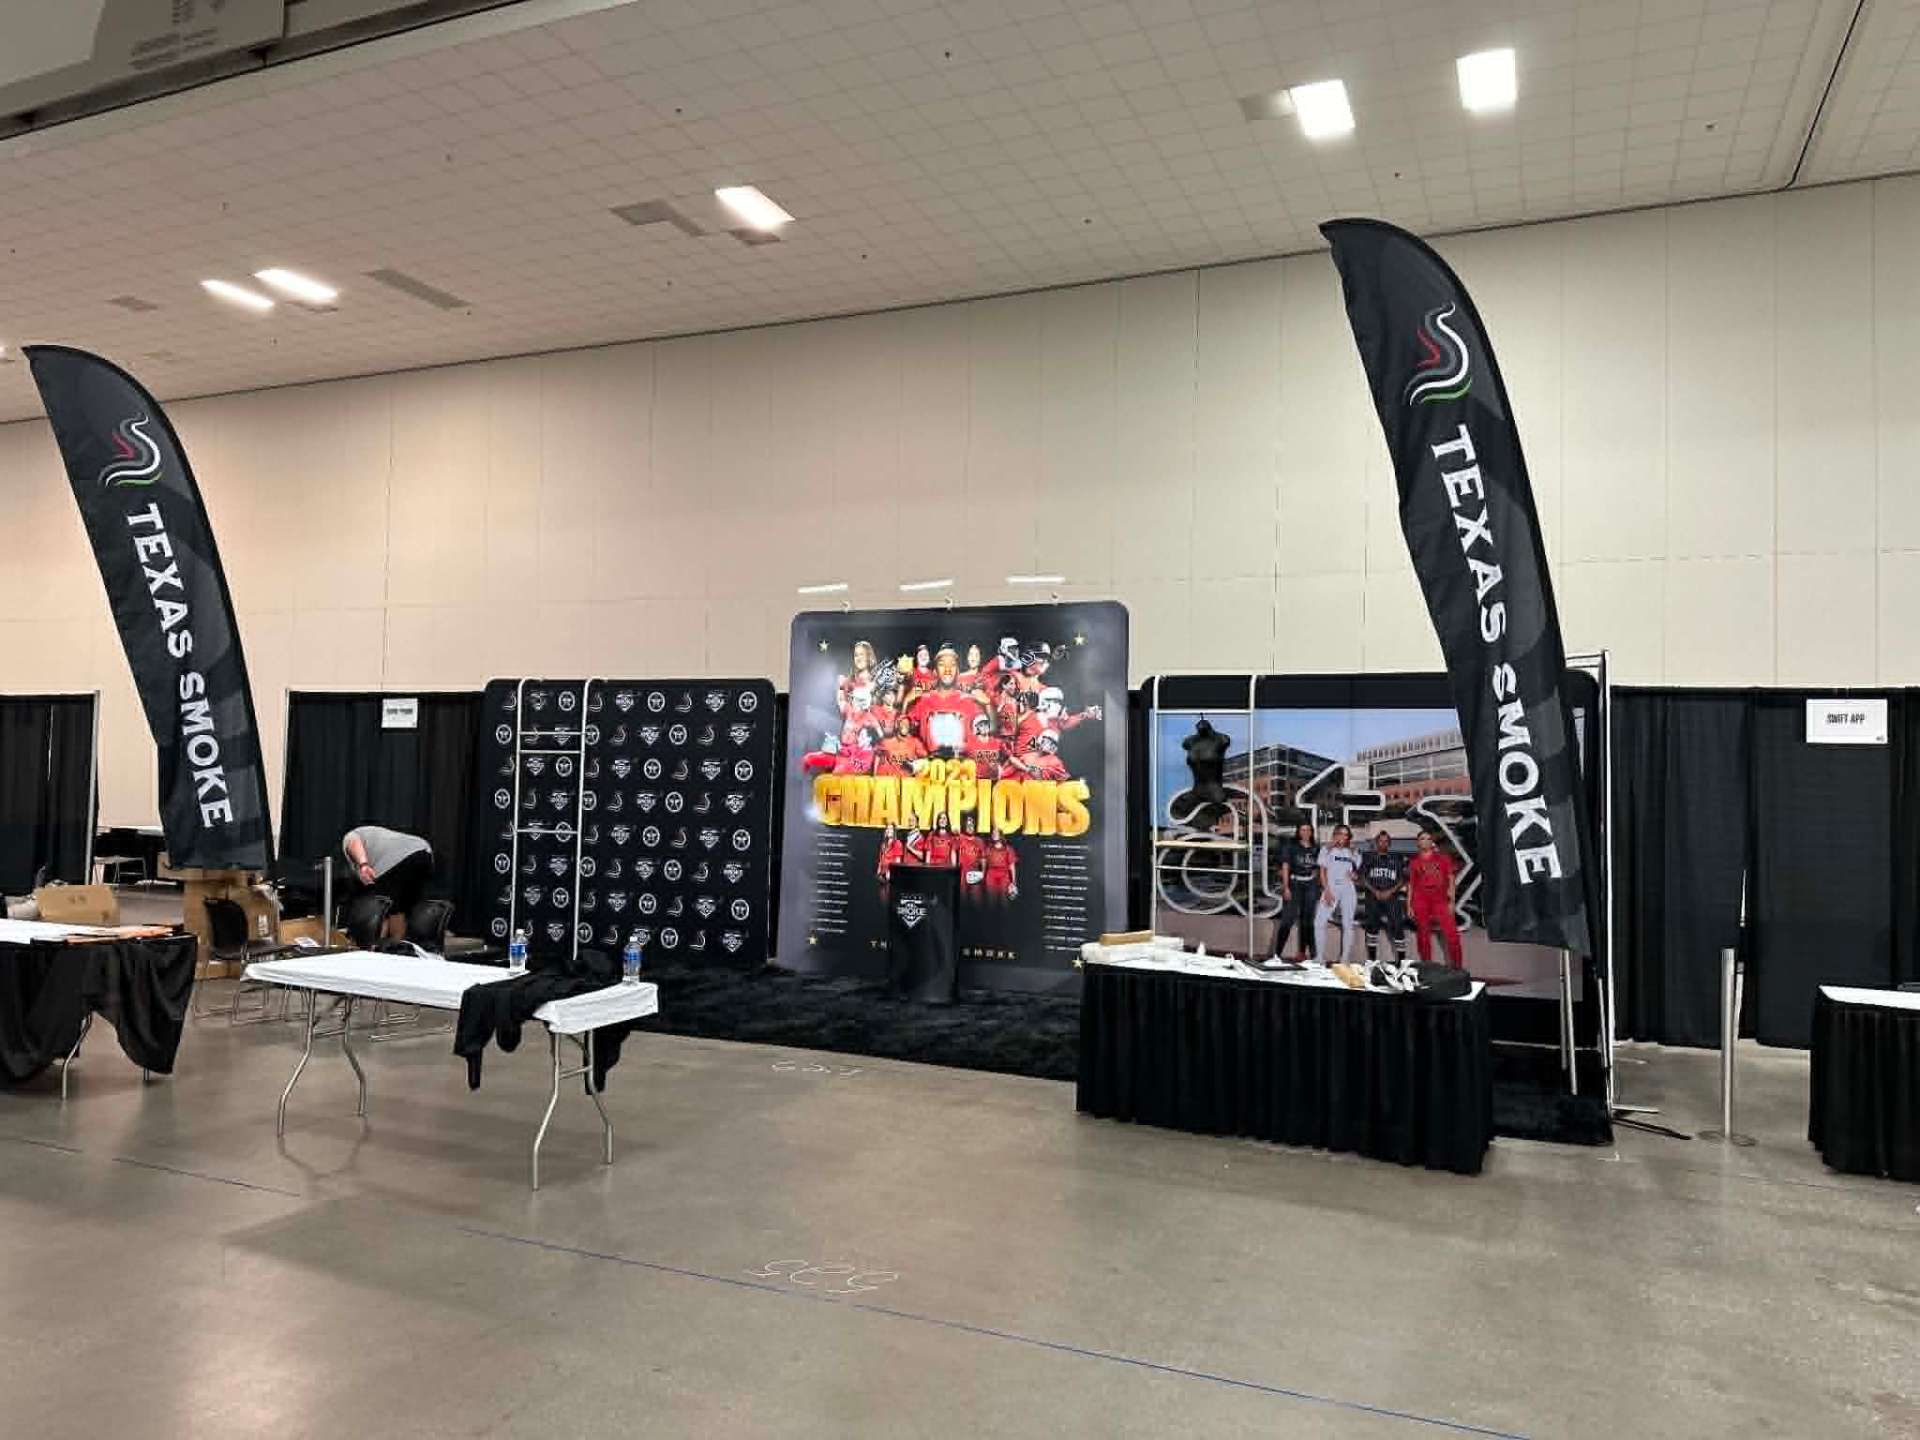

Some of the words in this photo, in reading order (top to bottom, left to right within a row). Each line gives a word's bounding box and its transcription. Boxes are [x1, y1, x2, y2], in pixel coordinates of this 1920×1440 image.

[127, 502, 193, 658] TEXAS
[180, 671, 233, 827] SMOKE
[1431, 423, 1506, 644] TEXAS
[1493, 662, 1562, 886] SMOKE
[1850, 713, 1865, 724] APP
[813, 772, 1091, 837] CHAMPIONS
